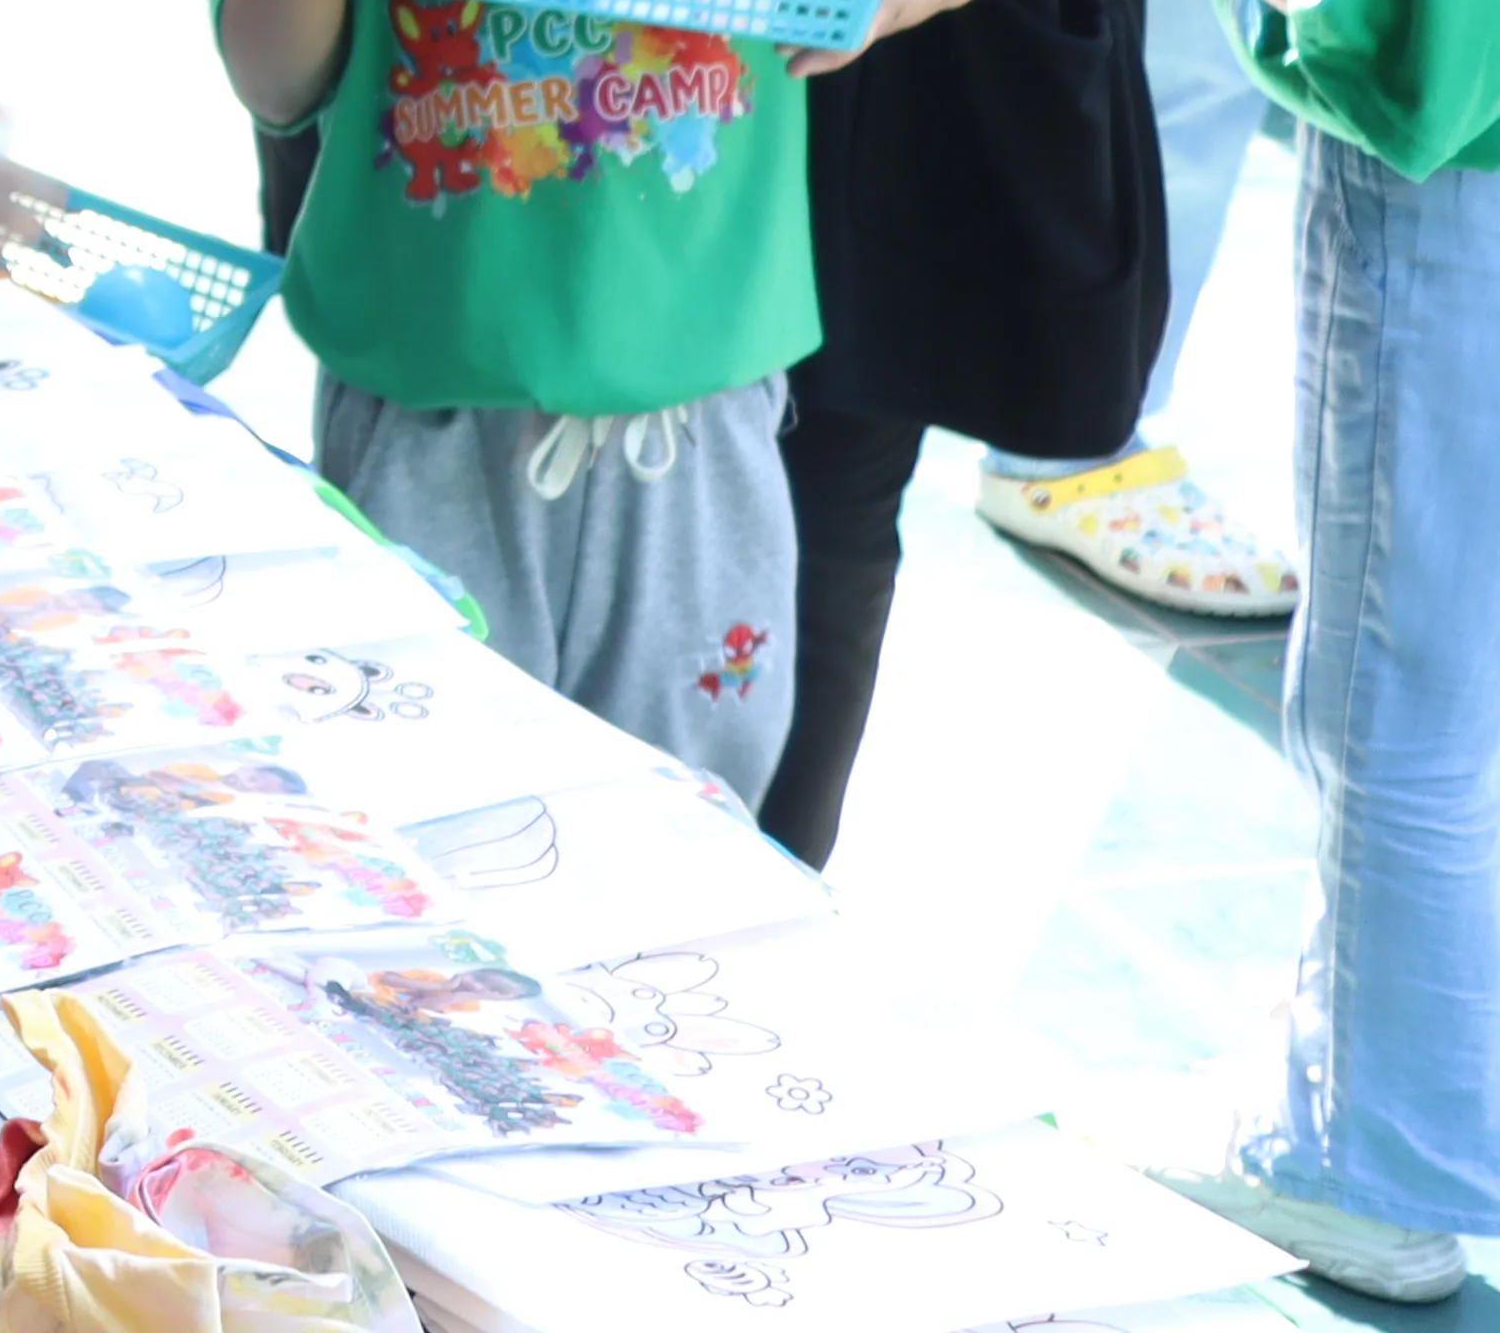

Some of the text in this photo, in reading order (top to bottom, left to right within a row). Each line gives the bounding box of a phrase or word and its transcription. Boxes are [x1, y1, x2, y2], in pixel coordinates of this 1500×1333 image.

[488, 8, 614, 61] PCC
[394, 63, 731, 144] SUMMER CAMP
